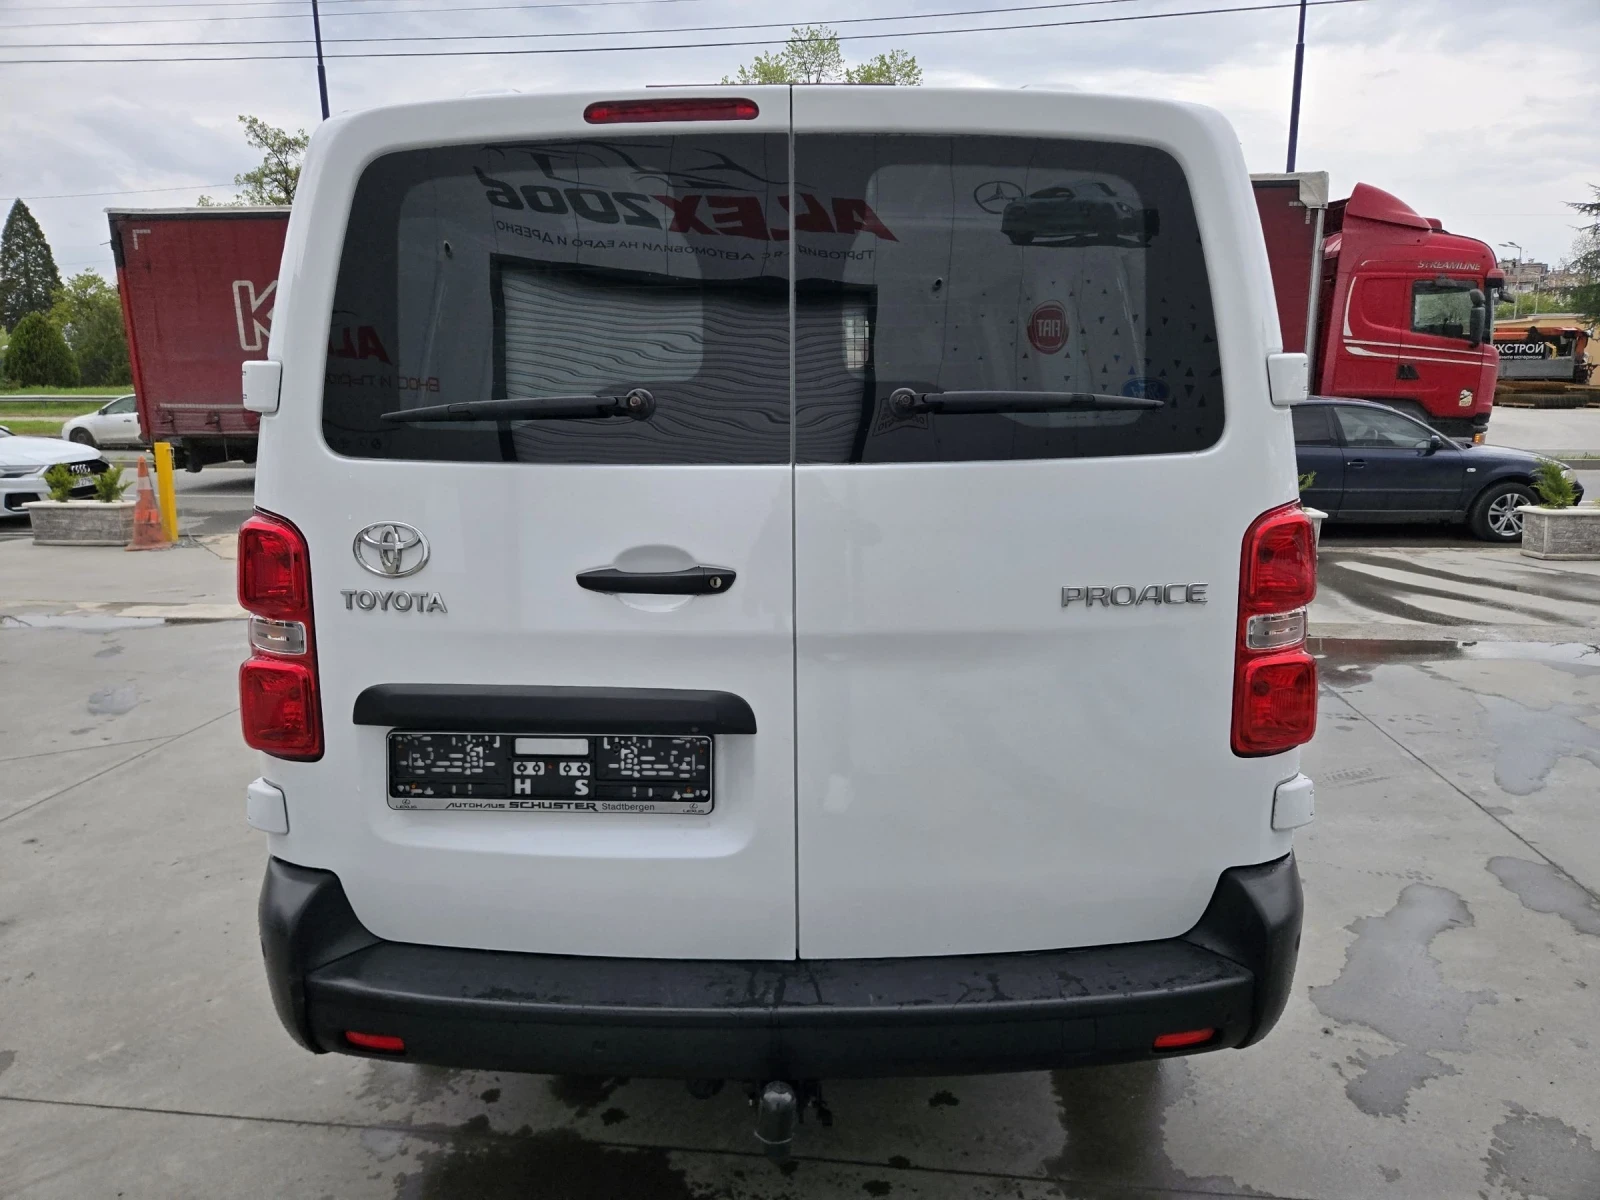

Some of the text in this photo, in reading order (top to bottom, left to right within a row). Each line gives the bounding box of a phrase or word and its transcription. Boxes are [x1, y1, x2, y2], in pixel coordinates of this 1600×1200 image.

[1417, 261, 1480, 271] STREAMLINE
[340, 589, 448, 613] TOYOTA
[1061, 582, 1208, 608] PROACE
[514, 778, 531, 794] H
[574, 779, 589, 795] S
[509, 801, 598, 811] SCHUSTER
[601, 803, 655, 812] Stadtbergen
